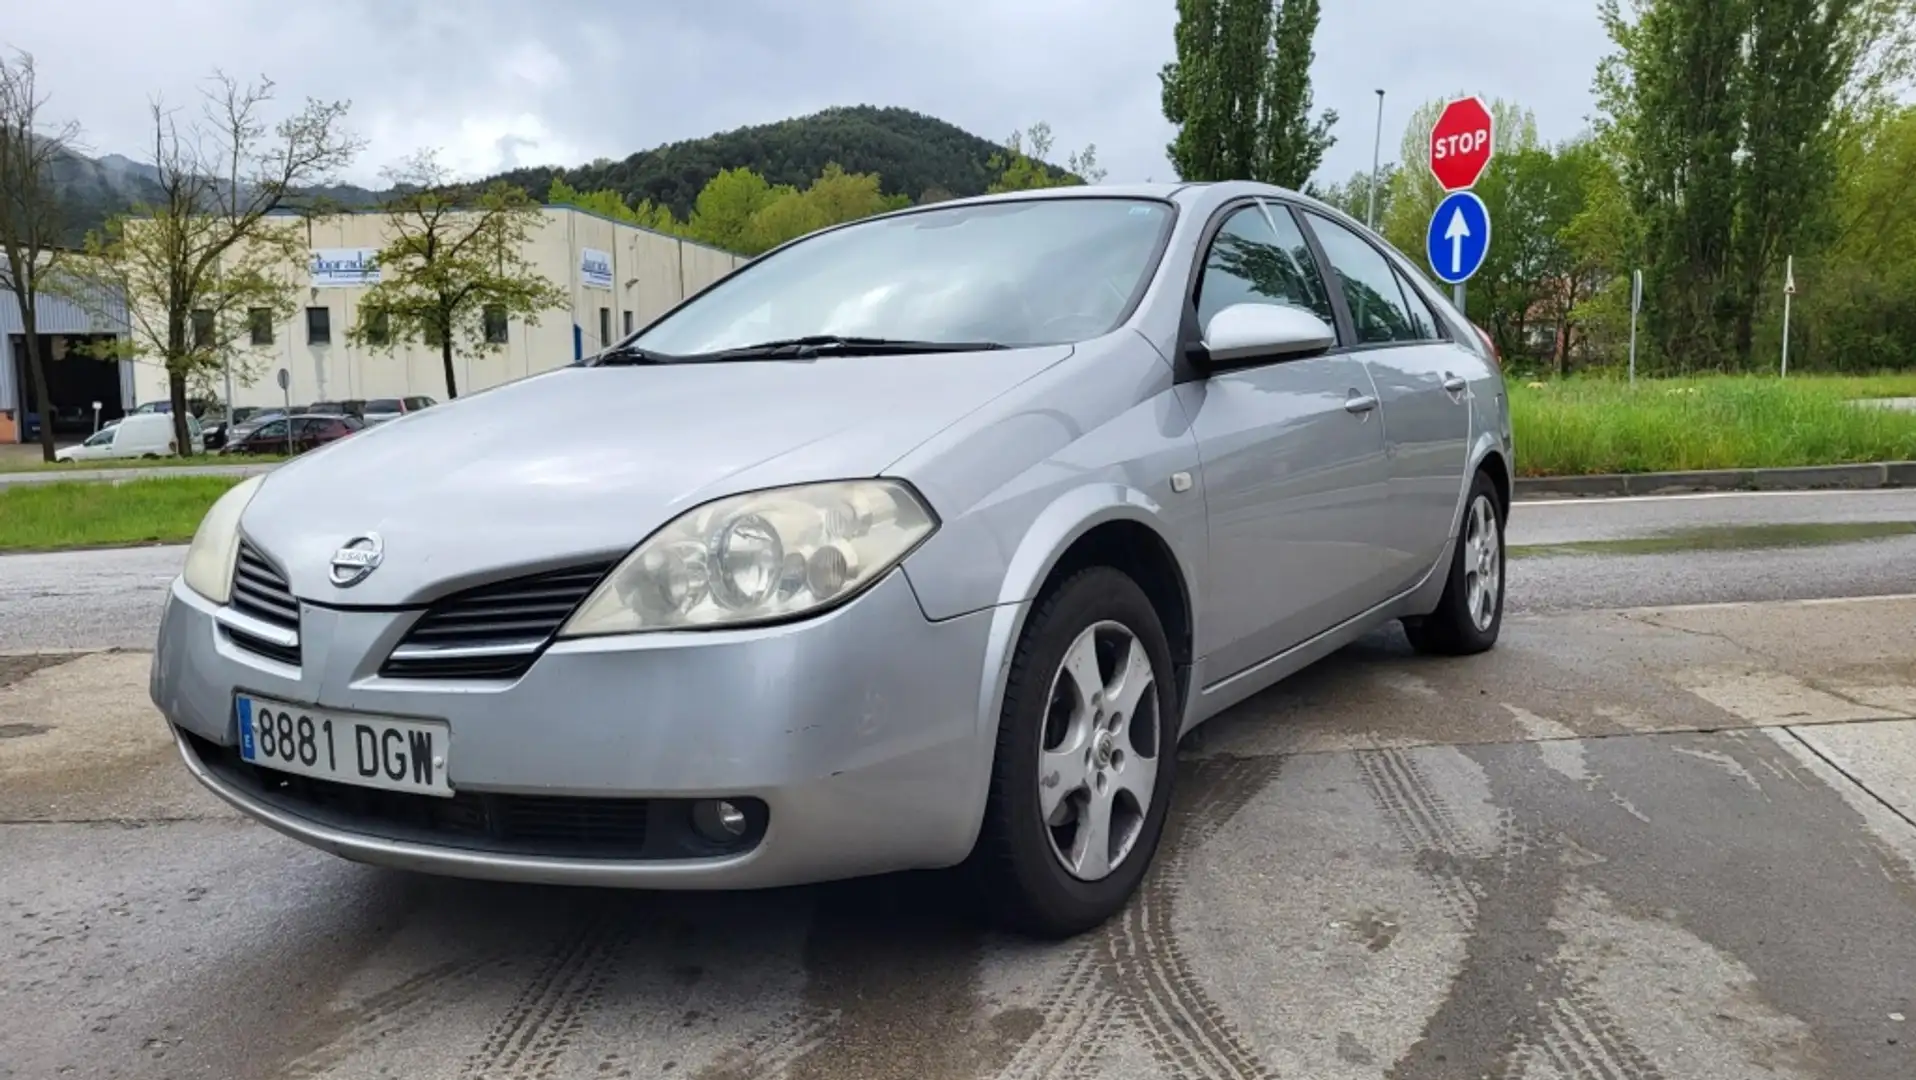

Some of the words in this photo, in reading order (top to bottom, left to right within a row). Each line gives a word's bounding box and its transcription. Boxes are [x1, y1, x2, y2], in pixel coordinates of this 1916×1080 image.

[1434, 128, 1488, 159] STOP
[259, 708, 336, 771] 8881
[355, 724, 433, 785] DGW
